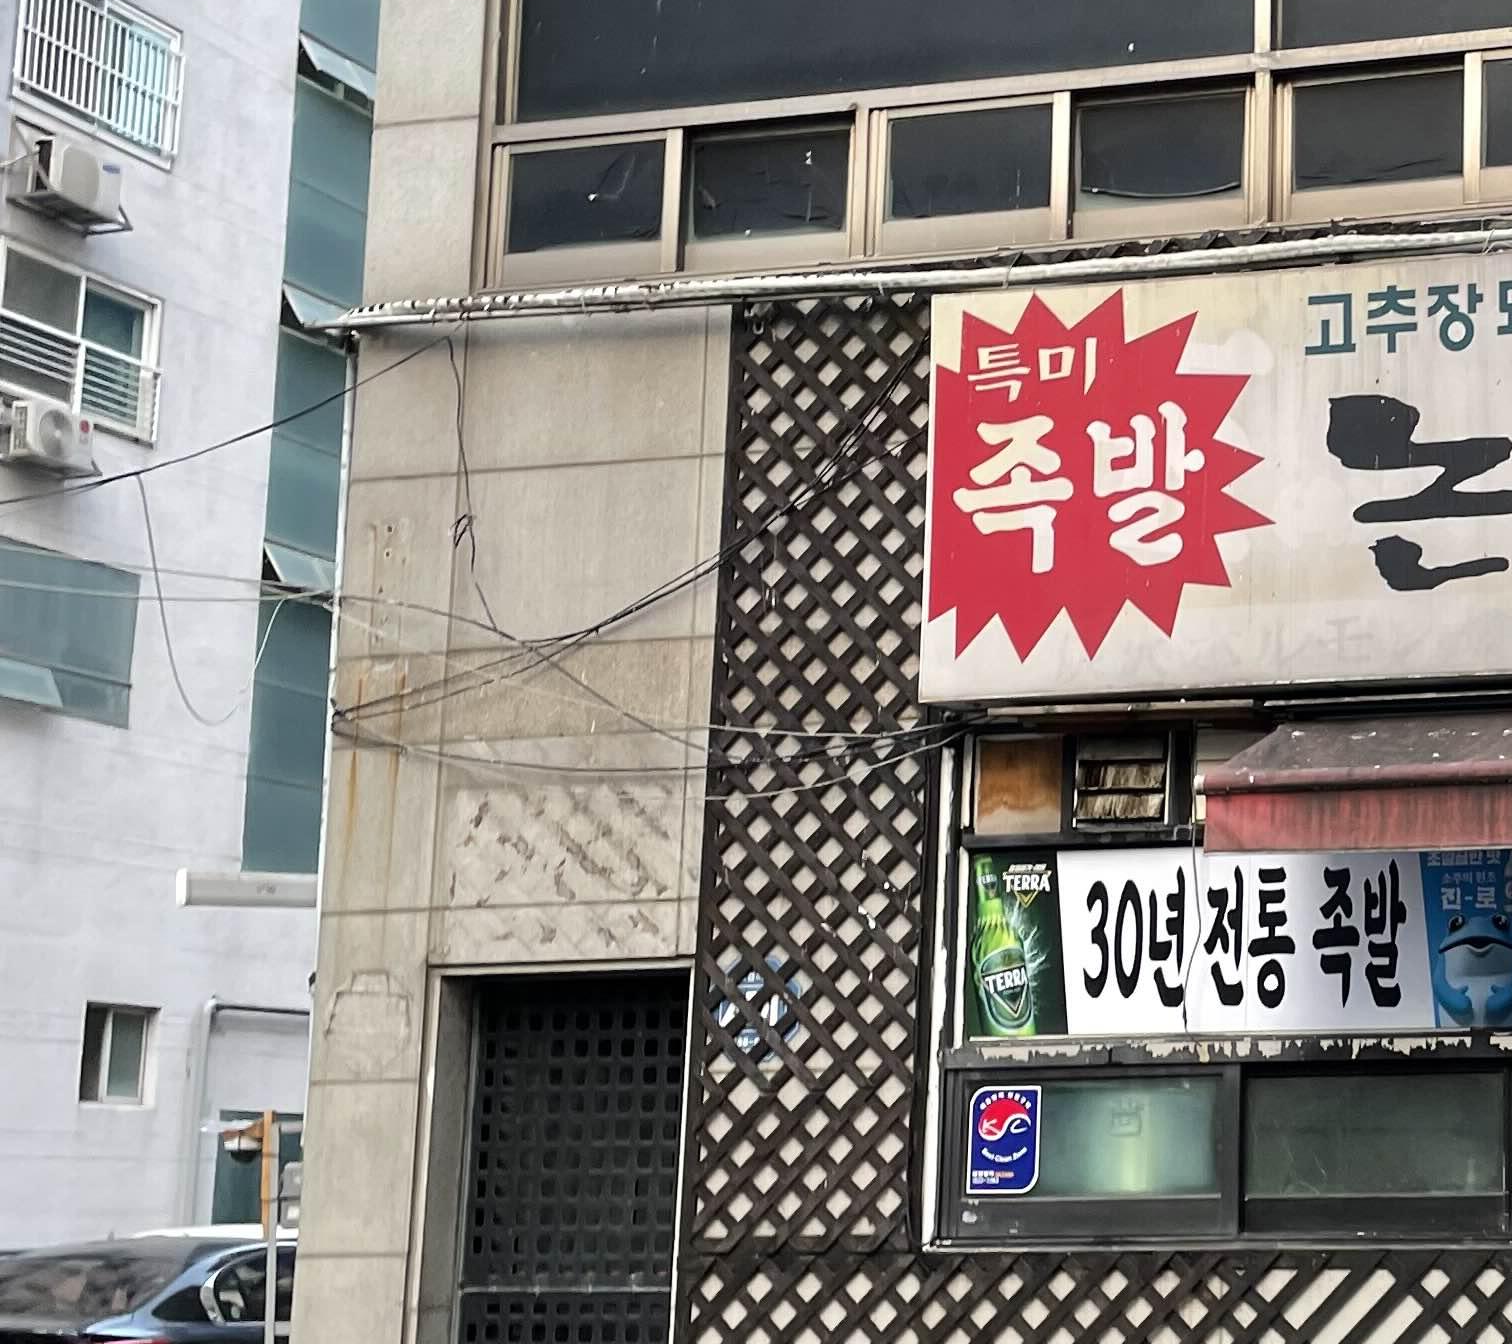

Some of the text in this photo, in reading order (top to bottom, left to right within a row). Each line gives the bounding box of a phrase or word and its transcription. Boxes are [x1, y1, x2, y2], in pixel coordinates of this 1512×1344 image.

[967, 337, 1098, 402] 특미
[952, 401, 1205, 574] 족발
[1002, 871, 1052, 893] TERRA
[1082, 858, 1407, 1009] 30년 전통 족발
[984, 966, 1028, 995] TERRA
